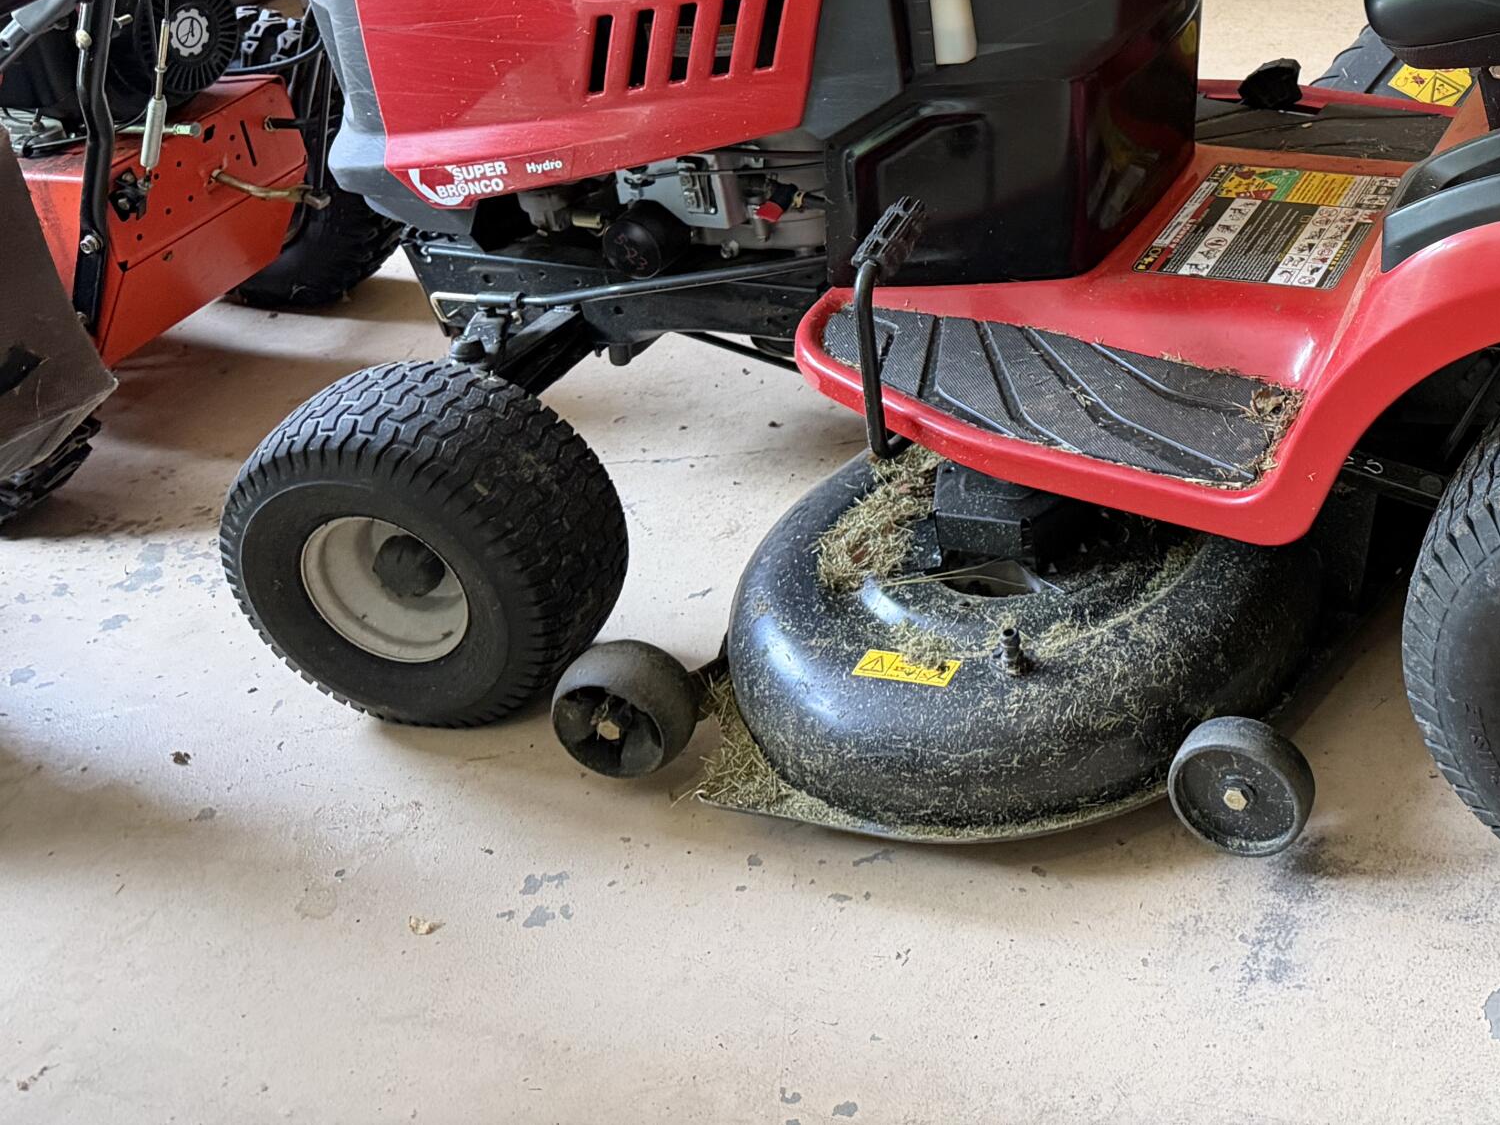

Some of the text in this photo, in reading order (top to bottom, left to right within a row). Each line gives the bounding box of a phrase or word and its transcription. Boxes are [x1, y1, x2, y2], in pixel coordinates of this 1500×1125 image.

[452, 161, 508, 182] SUPER
[525, 158, 564, 174] Hydro
[435, 177, 505, 200] BRONCO
